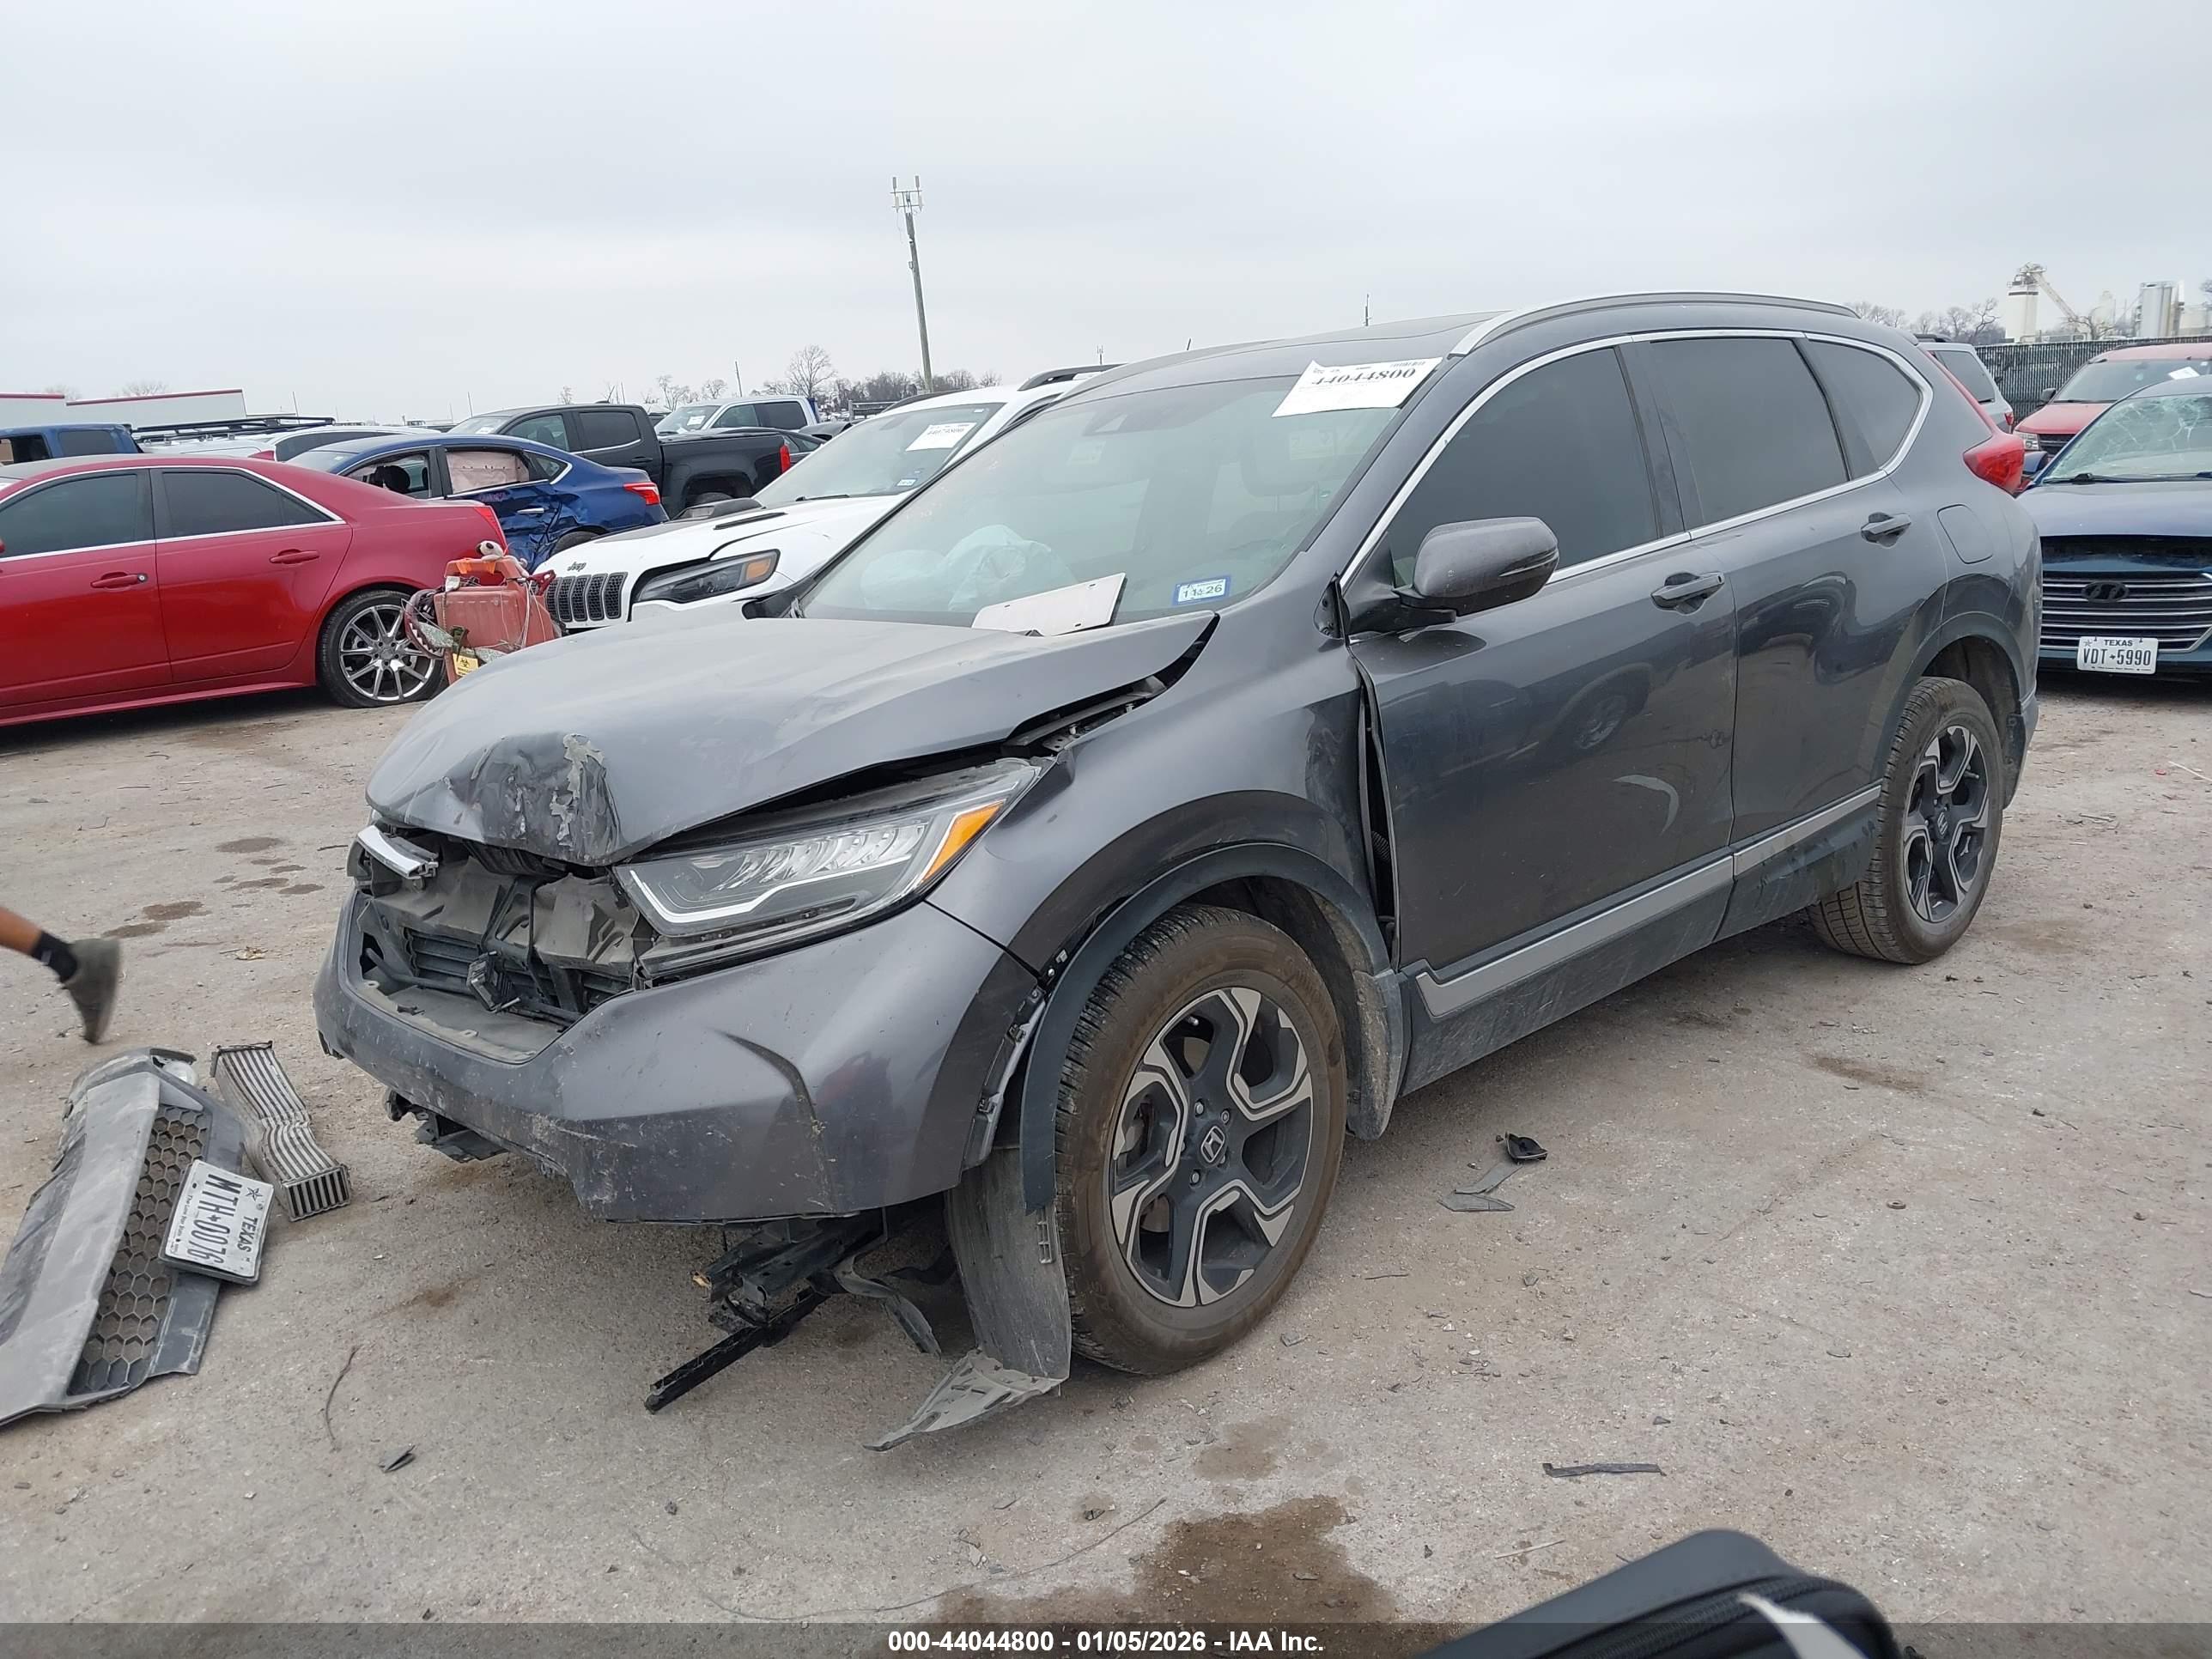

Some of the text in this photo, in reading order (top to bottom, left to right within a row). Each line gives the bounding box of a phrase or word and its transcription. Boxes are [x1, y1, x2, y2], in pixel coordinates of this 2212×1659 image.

[1311, 368, 1416, 386] 44044800
[567, 562, 586, 572] Jeep
[1206, 584, 1223, 594] 26
[236, 1216, 258, 1253] TEXAS
